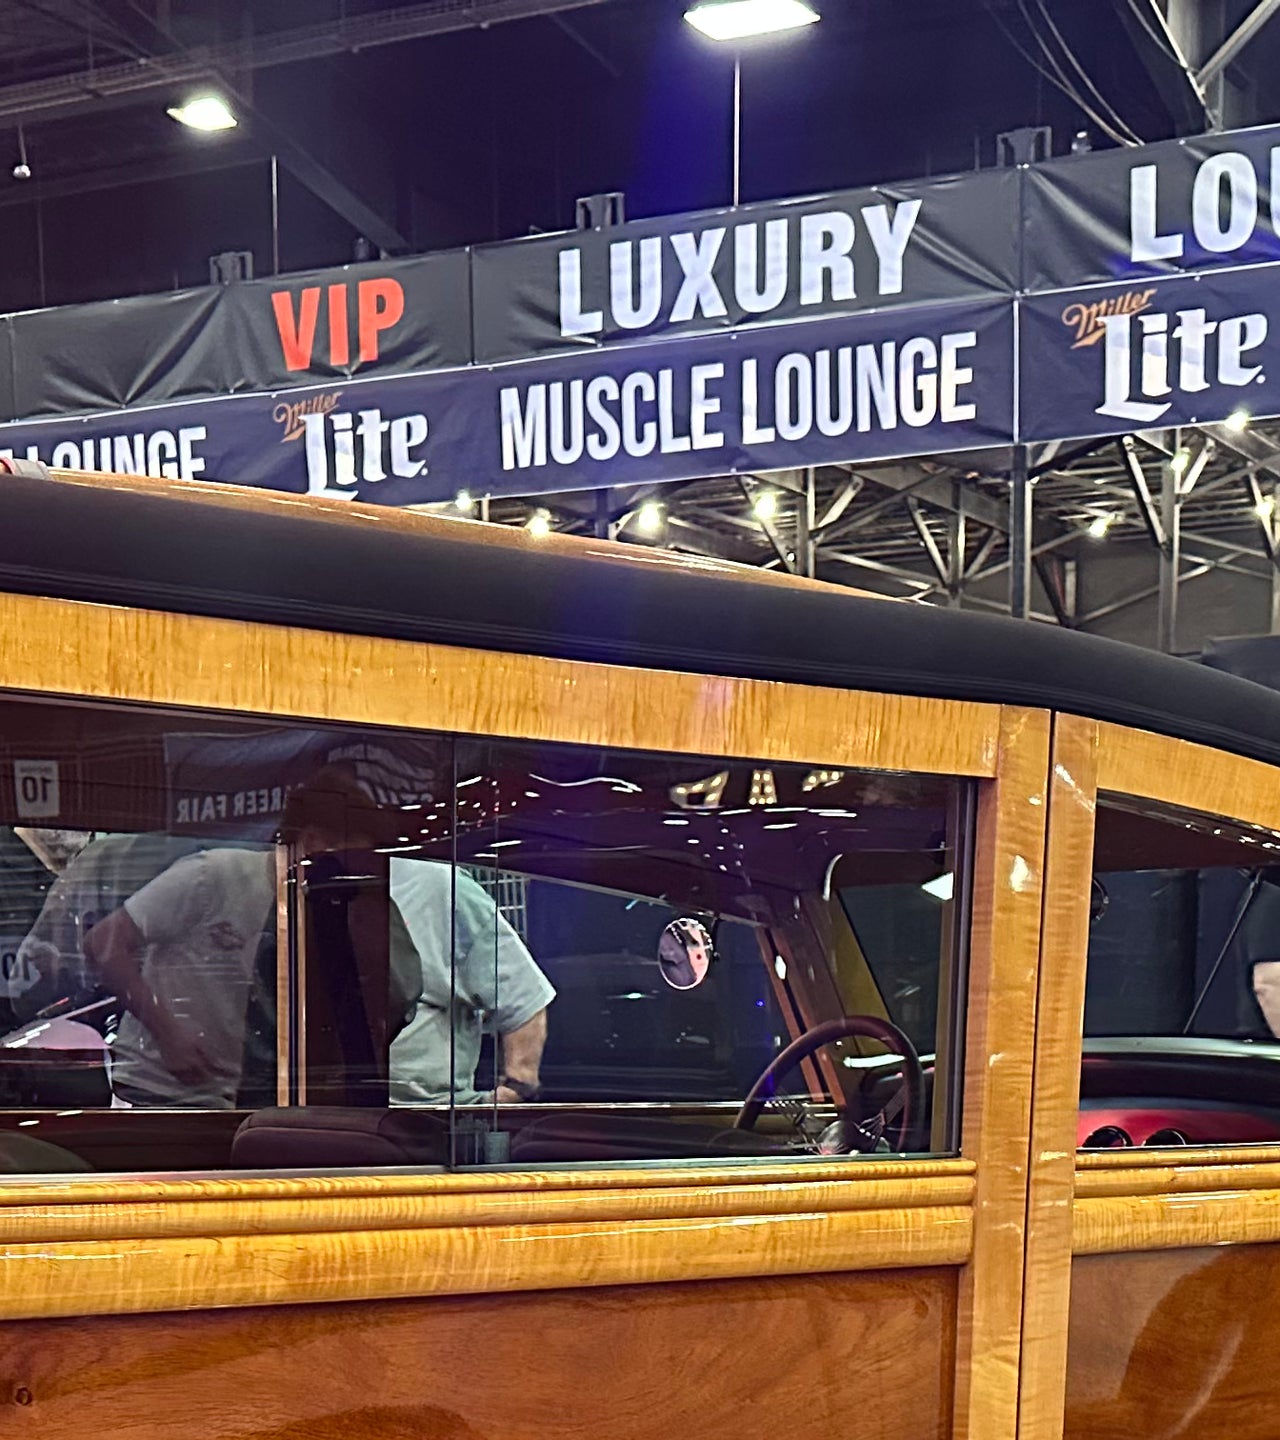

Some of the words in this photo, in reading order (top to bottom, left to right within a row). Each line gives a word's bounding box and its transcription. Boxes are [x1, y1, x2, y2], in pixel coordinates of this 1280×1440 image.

[559, 199, 923, 337] LUXURY
[271, 278, 405, 371] VIP
[1061, 287, 1157, 350] Miller
[1095, 307, 1269, 422] Lite
[273, 391, 344, 443] Miller
[500, 364, 726, 471] MUSCLE
[742, 332, 977, 446] LOUNGE
[298, 409, 429, 501] Lite
